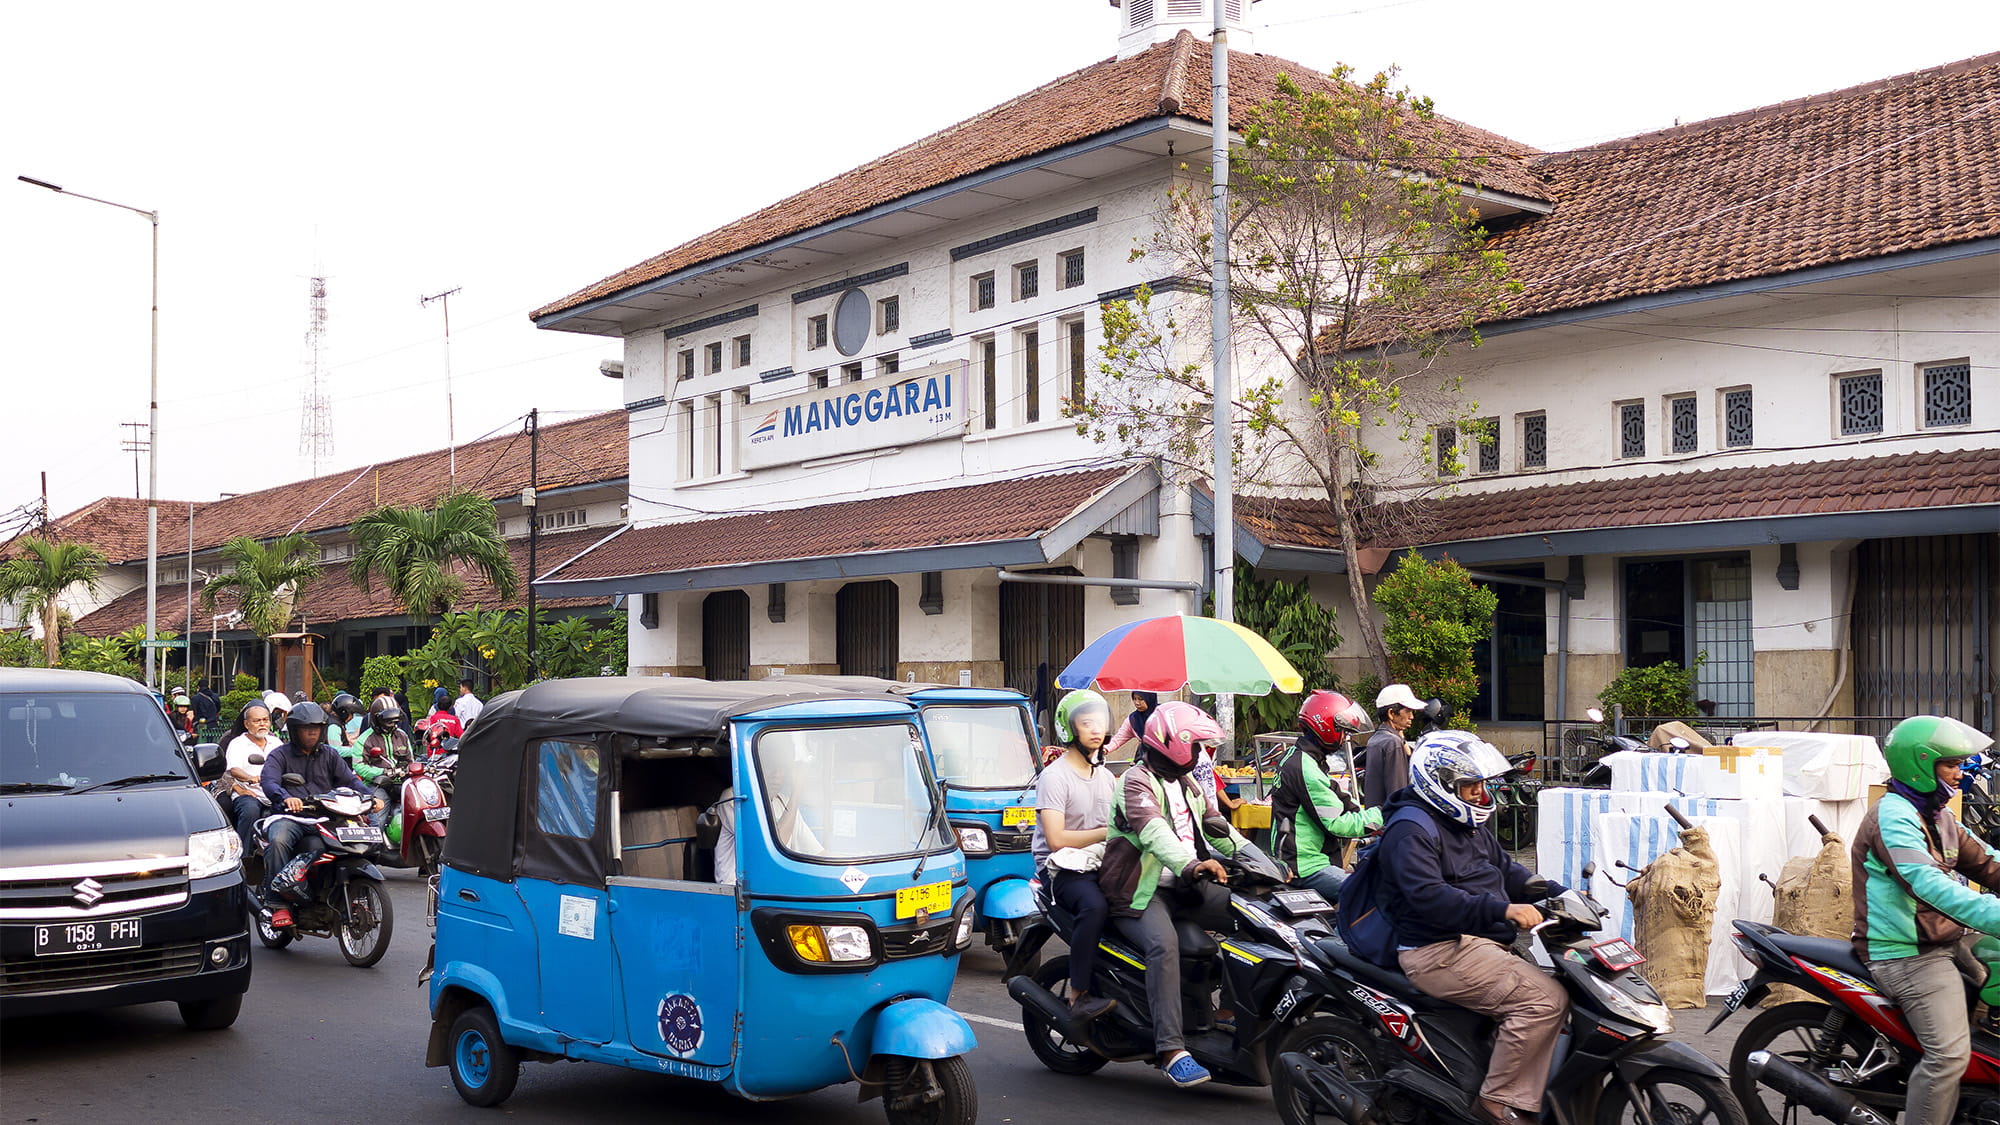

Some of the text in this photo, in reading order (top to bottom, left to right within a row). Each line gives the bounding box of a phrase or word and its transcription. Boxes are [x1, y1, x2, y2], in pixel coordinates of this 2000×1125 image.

[783, 374, 951, 438] MANGGARAI
[935, 413, 944, 424] 13
[945, 412, 951, 421] M
[844, 874, 864, 883] CNG
[899, 891, 904, 904] B
[39, 921, 139, 946] B 1158 PFH
[665, 999, 698, 1021] JAKARTA
[667, 1031, 693, 1051] BARAT
